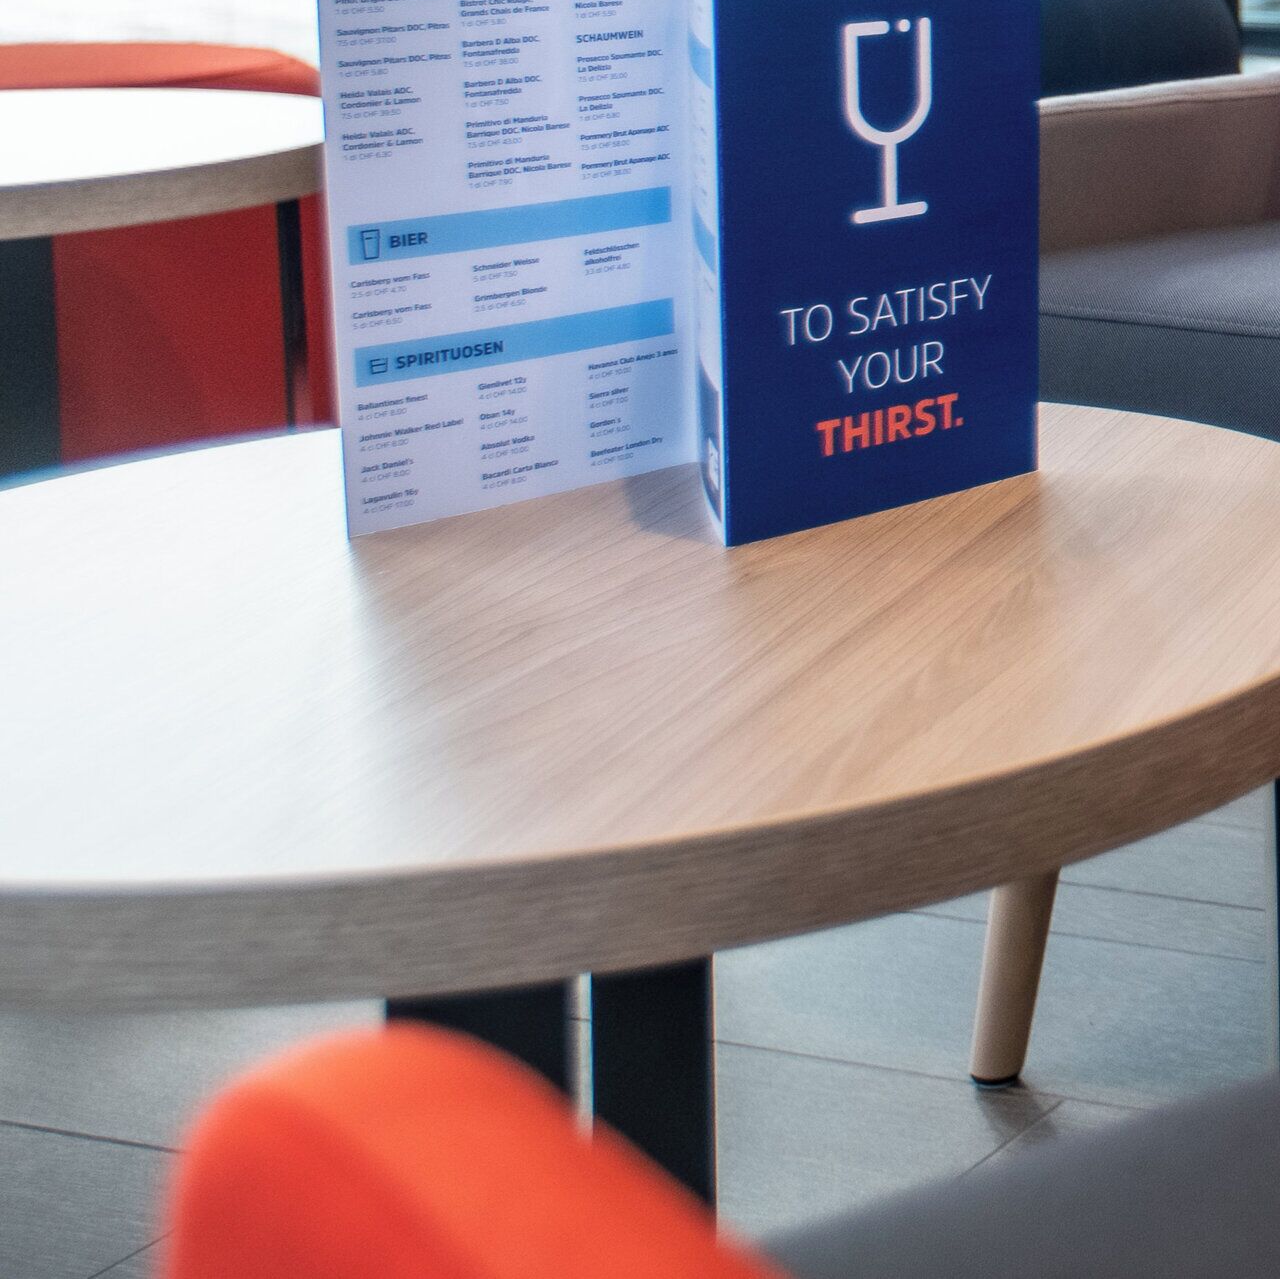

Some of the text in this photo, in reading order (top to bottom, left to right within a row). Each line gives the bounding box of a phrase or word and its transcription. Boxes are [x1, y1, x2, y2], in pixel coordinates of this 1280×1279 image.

[576, 30, 644, 43] SCHAUMWEIN
[389, 232, 429, 249] BIER
[780, 274, 992, 346] TO SATISFY
[395, 341, 504, 369] SPIRITUOSEN
[838, 341, 944, 394] YOUR
[816, 392, 964, 457] THIRST.
